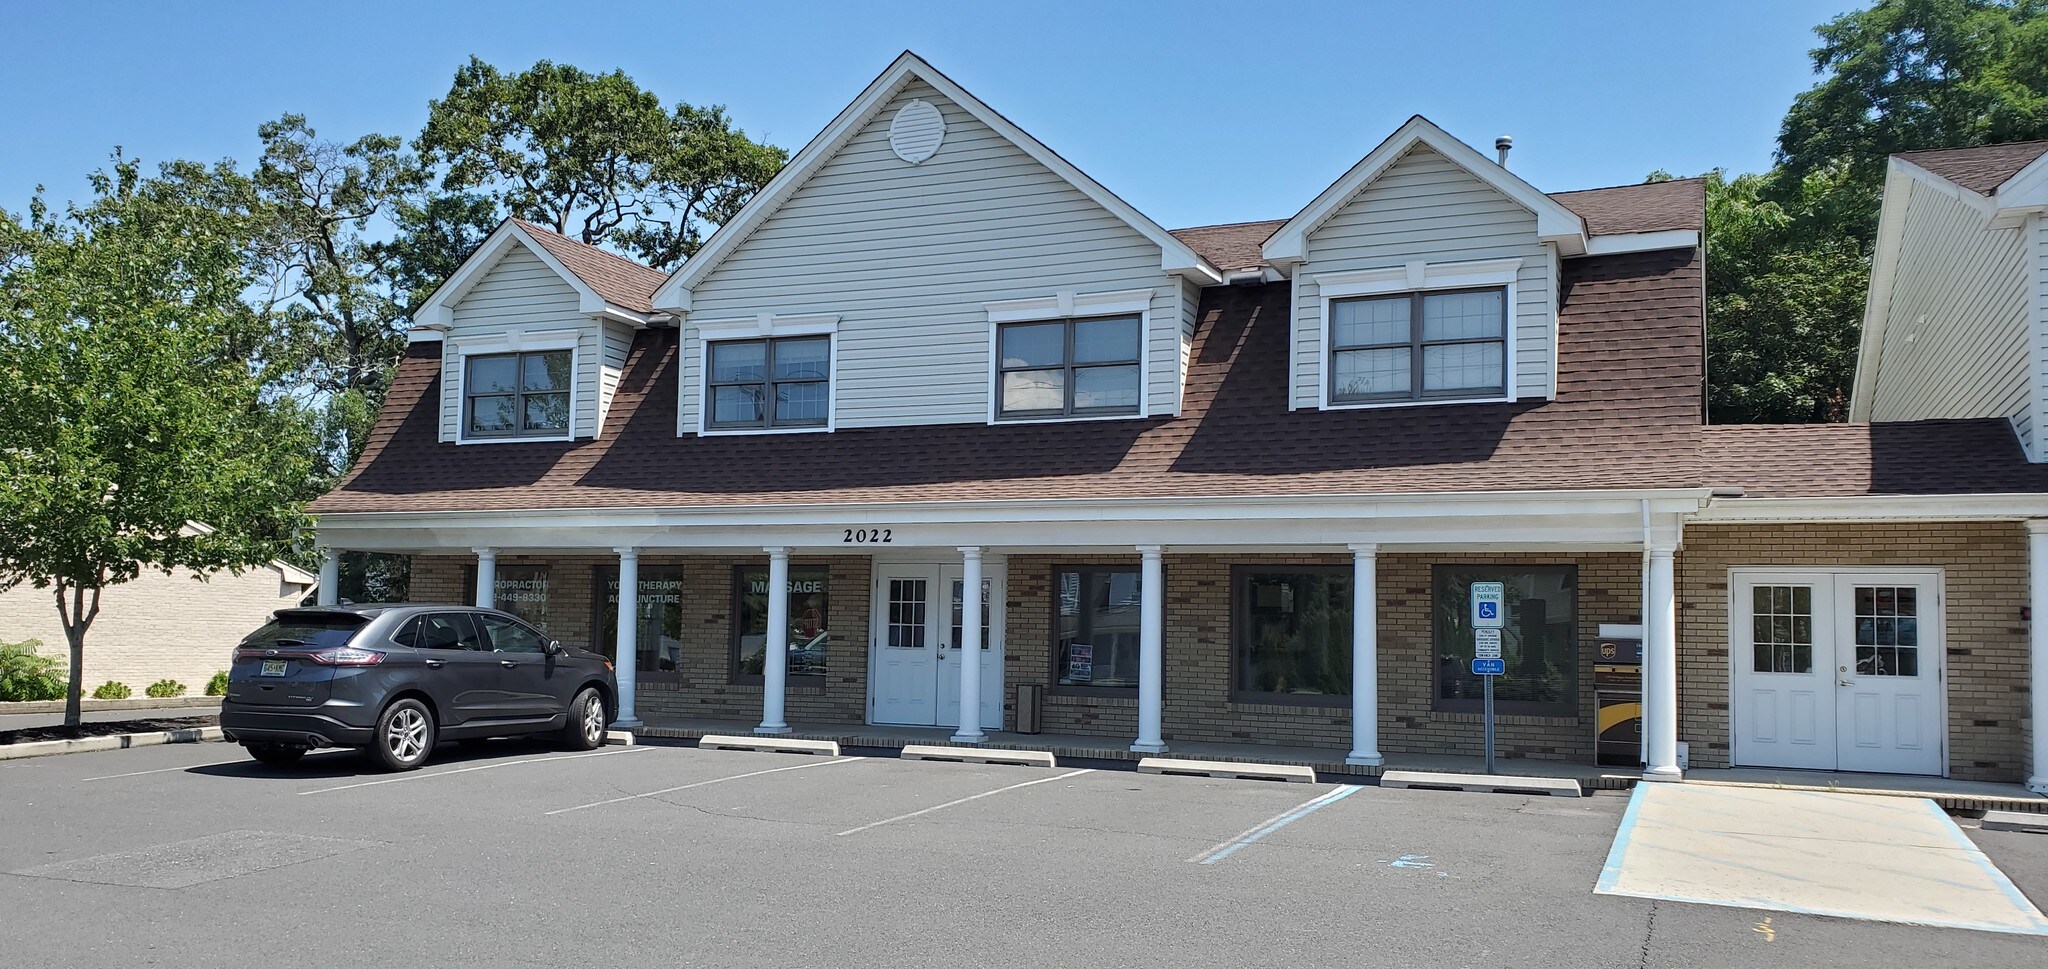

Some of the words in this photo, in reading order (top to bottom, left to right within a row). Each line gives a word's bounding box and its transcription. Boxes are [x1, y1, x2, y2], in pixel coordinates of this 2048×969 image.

[843, 529, 892, 543] 2022
[495, 580, 549, 589] ROPRACTOR
[638, 581, 682, 590] THERAPY
[751, 581, 821, 593] MASAGE
[1474, 585, 1501, 593] RESERVED
[494, 593, 547, 602] -449-8330
